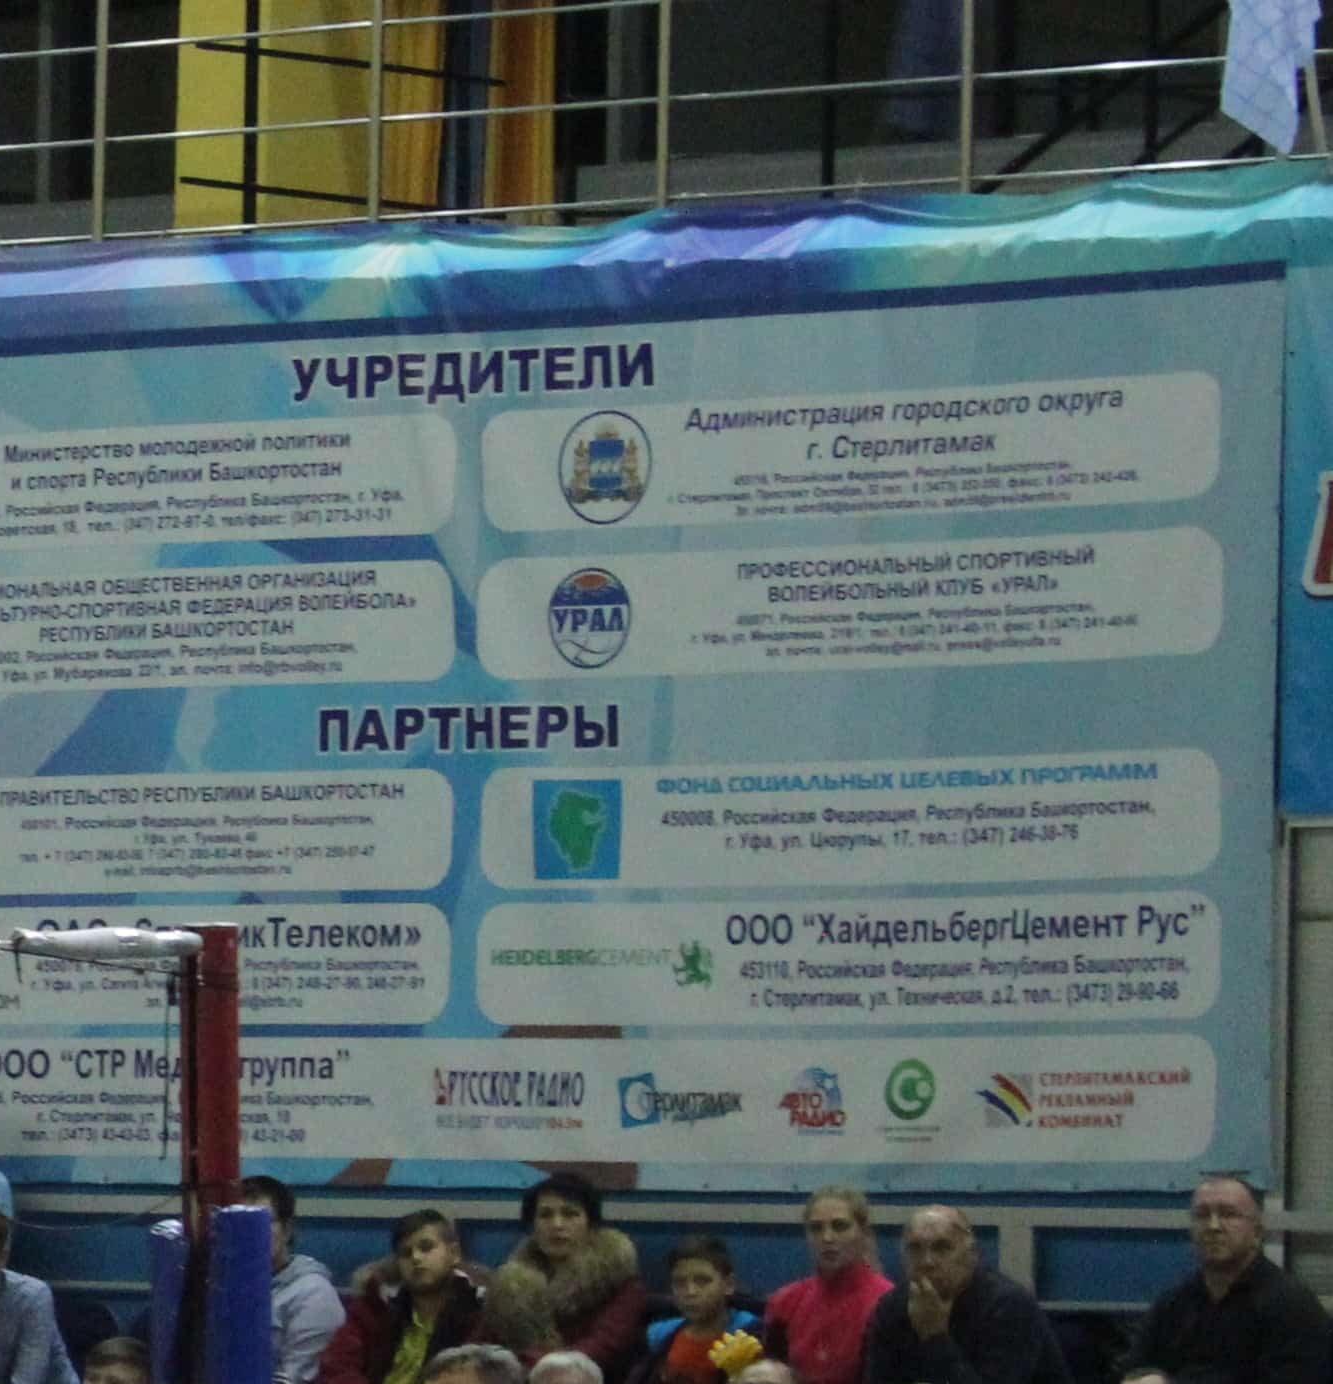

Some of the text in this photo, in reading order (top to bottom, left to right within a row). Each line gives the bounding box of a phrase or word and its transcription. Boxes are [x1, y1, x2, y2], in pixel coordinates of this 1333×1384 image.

[292, 343, 655, 404] УЧРЕДИТЕЛИ
[684, 389, 1124, 433] Администрация городского округа
[3, 431, 351, 464] Министерство молодежной политики
[832, 433, 997, 459] Стерлитамак
[11, 459, 342, 494] и спорта Республики Башкортостан
[737, 545, 1094, 579] ПРОФЕССИОНАЛЬНЫЙ СПОРТИВНЫЙ
[101, 575, 243, 596] ОБЩЕСТВЕННАЯ
[248, 570, 376, 591] ОРГАНИЗАЦИЯ
[767, 581, 929, 602] ВОЛЕЙБОЛЬНЫЙ
[935, 577, 984, 595] КЛУБ
[187, 596, 292, 617] ФЕДЕРАЦИЯ
[38, 619, 294, 643] РЕСПУБЛИКИ БАШКОРТОСТАН
[554, 608, 624, 633] УРАЛ
[318, 704, 619, 752] ПАРТНЕРЫ
[655, 763, 1158, 796] ФОНД СОЦИАЛЬНЫХ ЦЕЛЕВЫХ ПРОГРАММ
[0, 783, 405, 807] ПРАВИТЕЛЬСТВО РЕСПУБЛИКИ БАШКОРТОСТАН
[726, 914, 793, 945] ООО
[492, 949, 672, 967] HEIDELBERGCEMENT
[527, 1072, 584, 1107] РАДИО
[1039, 1091, 1134, 1107] РЕКЛАМНЫЙ
[1037, 1113, 1125, 1129] КОМБИНАТ
